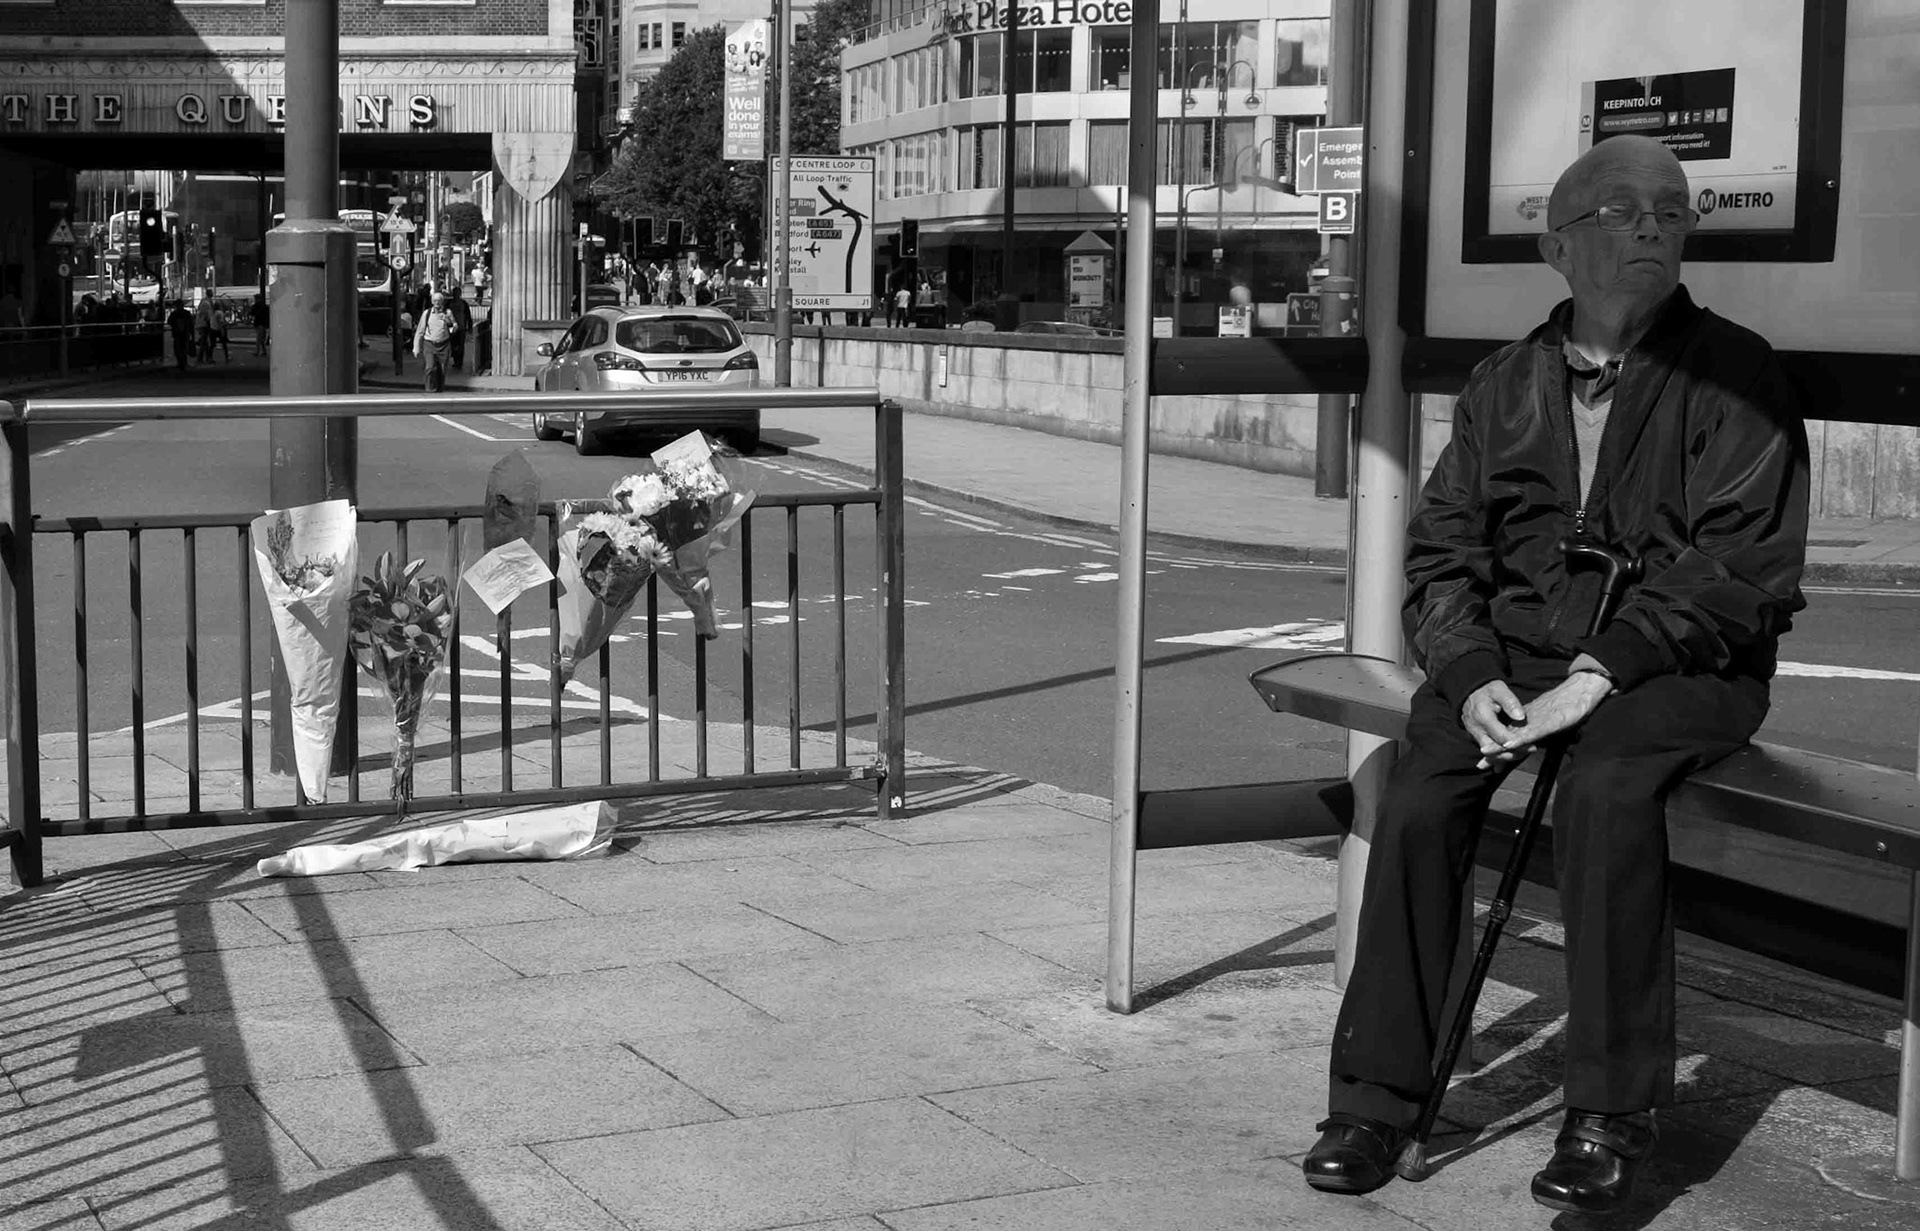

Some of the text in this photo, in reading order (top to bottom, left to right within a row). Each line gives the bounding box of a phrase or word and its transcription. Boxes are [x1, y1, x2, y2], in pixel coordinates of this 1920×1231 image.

[1050, 0, 1132, 24] Hote
[3, 93, 434, 124] THE QUENS
[728, 96, 761, 110] Well
[1603, 96, 1662, 110] KEEPINTOCH
[728, 109, 761, 121] done
[728, 122, 760, 132] in your
[1671, 132, 1704, 141] information
[796, 160, 831, 169] CENTRE
[832, 161, 856, 169] LOOP
[793, 174, 853, 184] All Loop Traffic
[798, 200, 816, 209] Ring
[1718, 192, 1774, 209] METRO
[1326, 196, 1347, 220] B
[795, 298, 831, 306] SQUARE
[665, 371, 709, 381] YP16 YXC
